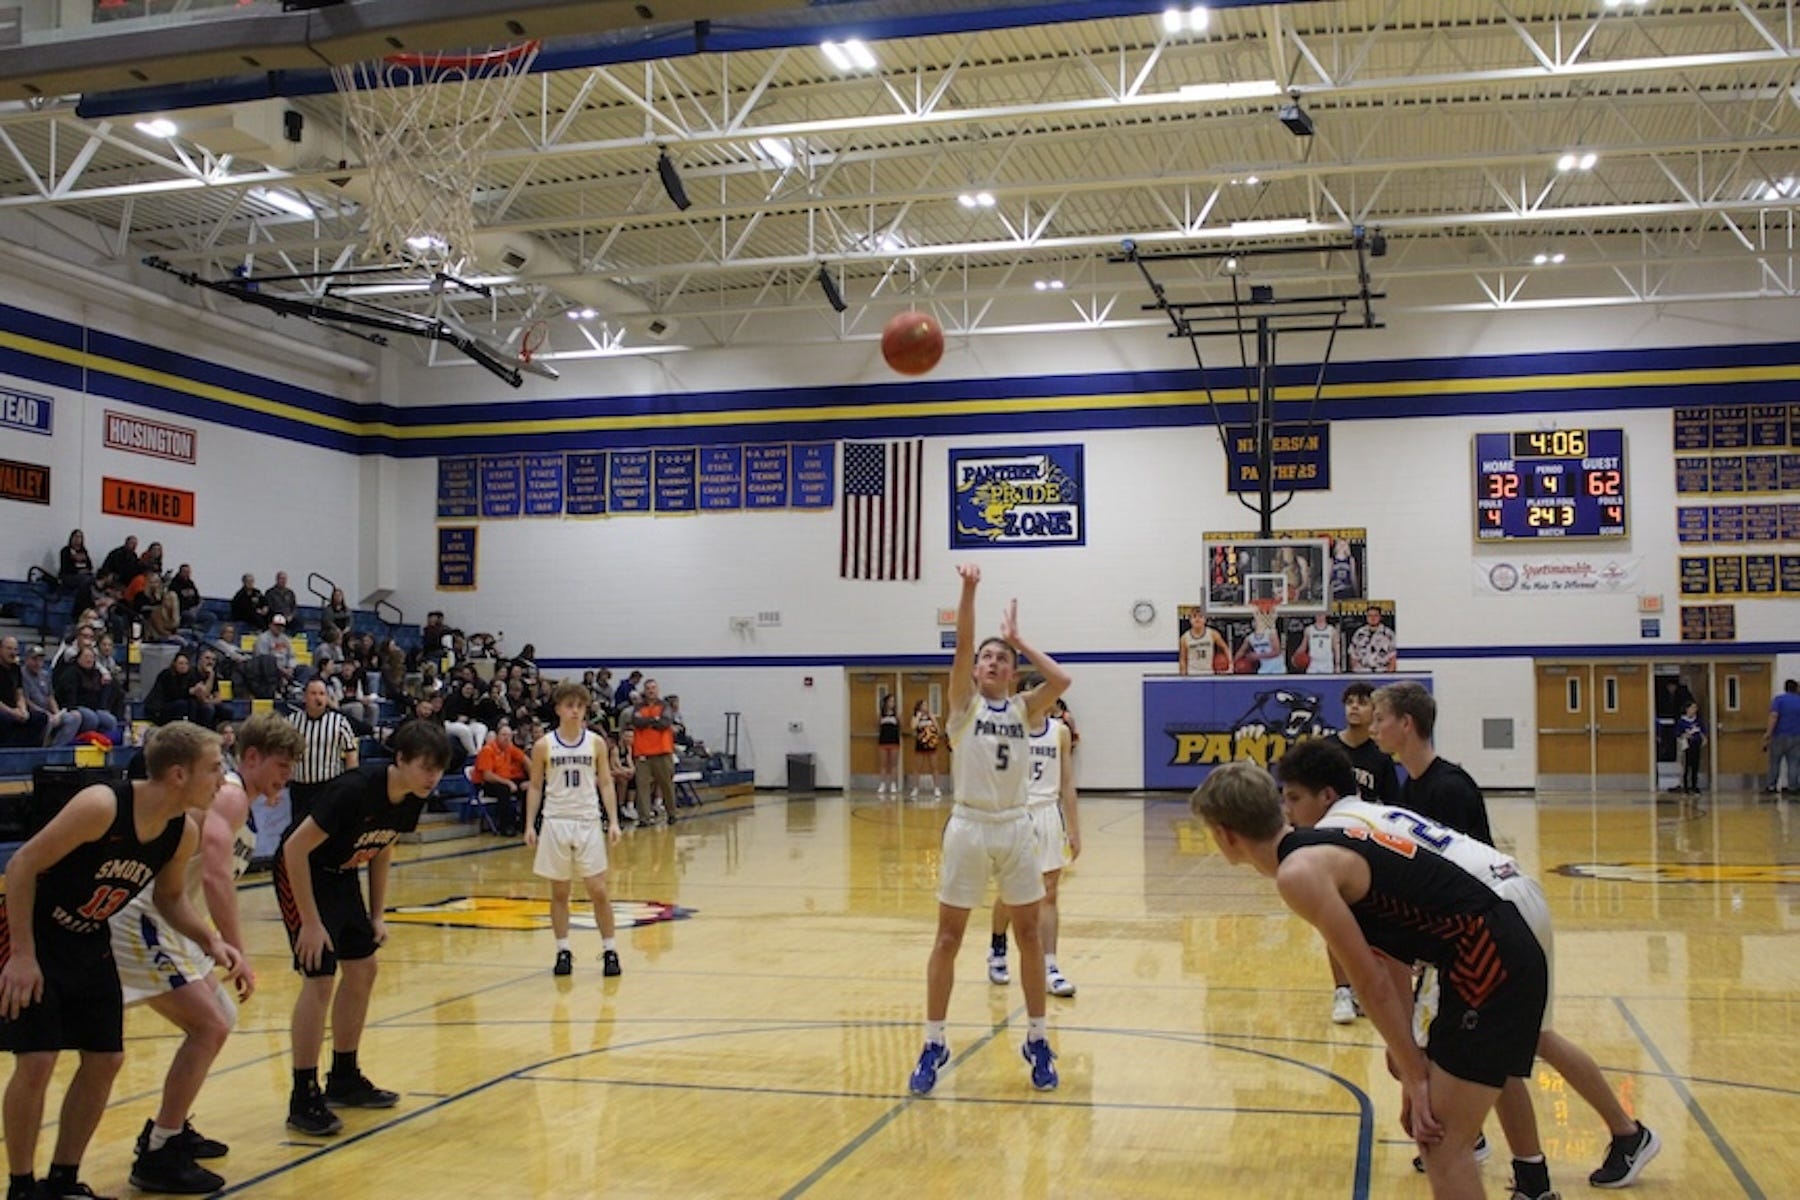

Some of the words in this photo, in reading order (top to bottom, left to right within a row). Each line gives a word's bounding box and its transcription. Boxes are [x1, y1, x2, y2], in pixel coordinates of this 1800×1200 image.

[110, 417, 191, 457] HOISINGTON
[1530, 430, 1585, 456] 4:06
[1241, 463, 1318, 480] PATHERS
[1482, 461, 1516, 473] HOME
[1582, 458, 1619, 470] GUEST
[962, 465, 1040, 484] PANTHER
[1543, 476, 1558, 493] 4
[1588, 471, 1621, 496] 62
[990, 483, 1061, 504] PRIDE
[1489, 474, 1519, 499] 32
[117, 486, 181, 517] LARNED
[1003, 510, 1073, 536] ZONE
[1488, 510, 1502, 527] 4
[1528, 507, 1555, 527] 24
[1561, 507, 1574, 527] 3
[1607, 506, 1622, 523] 4
[550, 755, 592, 768] PANTHERS
[995, 743, 1010, 771] 5
[564, 769, 580, 788] 10
[95, 859, 154, 888] SMOKY
[77, 884, 129, 920] 13
